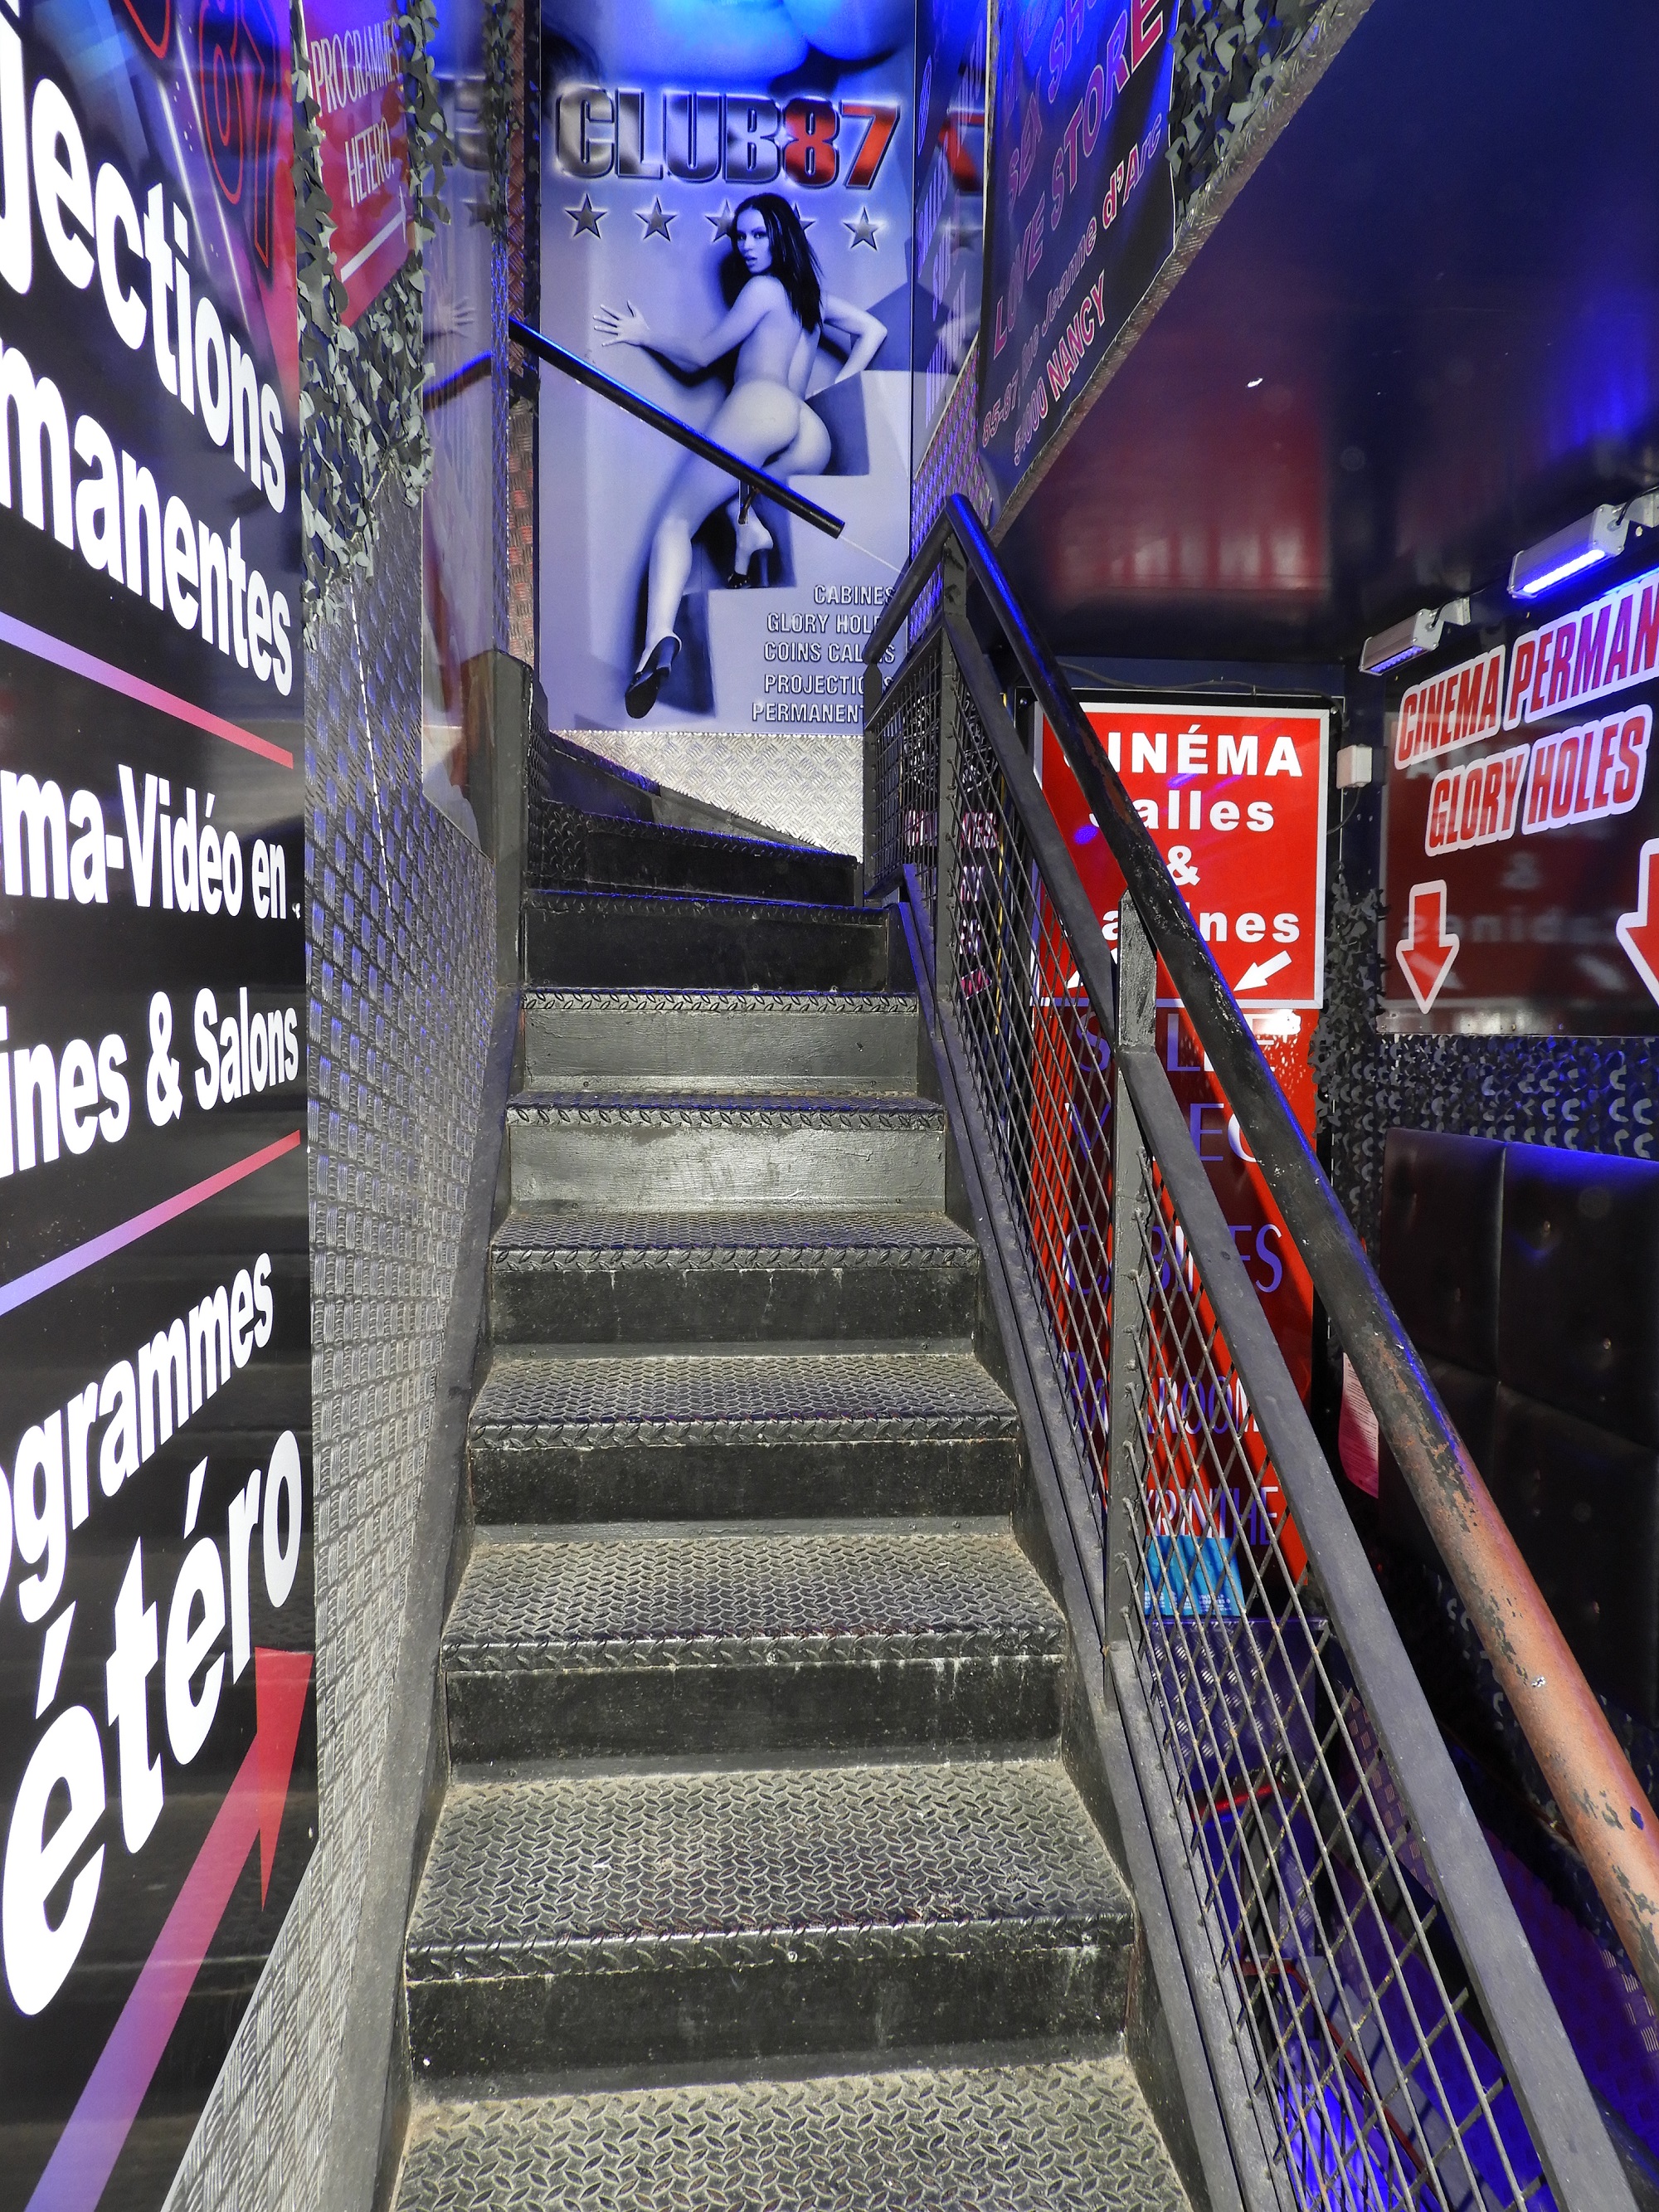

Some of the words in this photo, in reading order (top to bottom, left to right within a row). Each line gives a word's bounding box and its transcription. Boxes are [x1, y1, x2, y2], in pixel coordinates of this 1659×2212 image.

[310, 17, 400, 118] PROGRAMMES
[1050, 0, 1163, 231] STORE
[1047, 269, 1105, 402] NANCY
[0, 336, 292, 696] manentes
[764, 641, 821, 661] COINS
[828, 642, 895, 664] CALS
[767, 612, 830, 633] GLORY
[836, 615, 881, 634] HOL
[1398, 655, 1501, 762] CINEMA
[1508, 584, 1659, 720] PERMAN
[752, 702, 864, 724] PERMANEN
[1063, 724, 1302, 777] INÉMA
[0, 764, 244, 917] ma-Vidéo
[251, 837, 287, 919] en
[1089, 790, 1274, 832] alles
[1428, 752, 1525, 850] GLORY
[1530, 714, 1646, 827] HOLES
[146, 991, 183, 1128] &
[194, 987, 299, 1111] Salons
[0, 1251, 274, 1624] grammes
[2, 1430, 303, 2016] étéro
